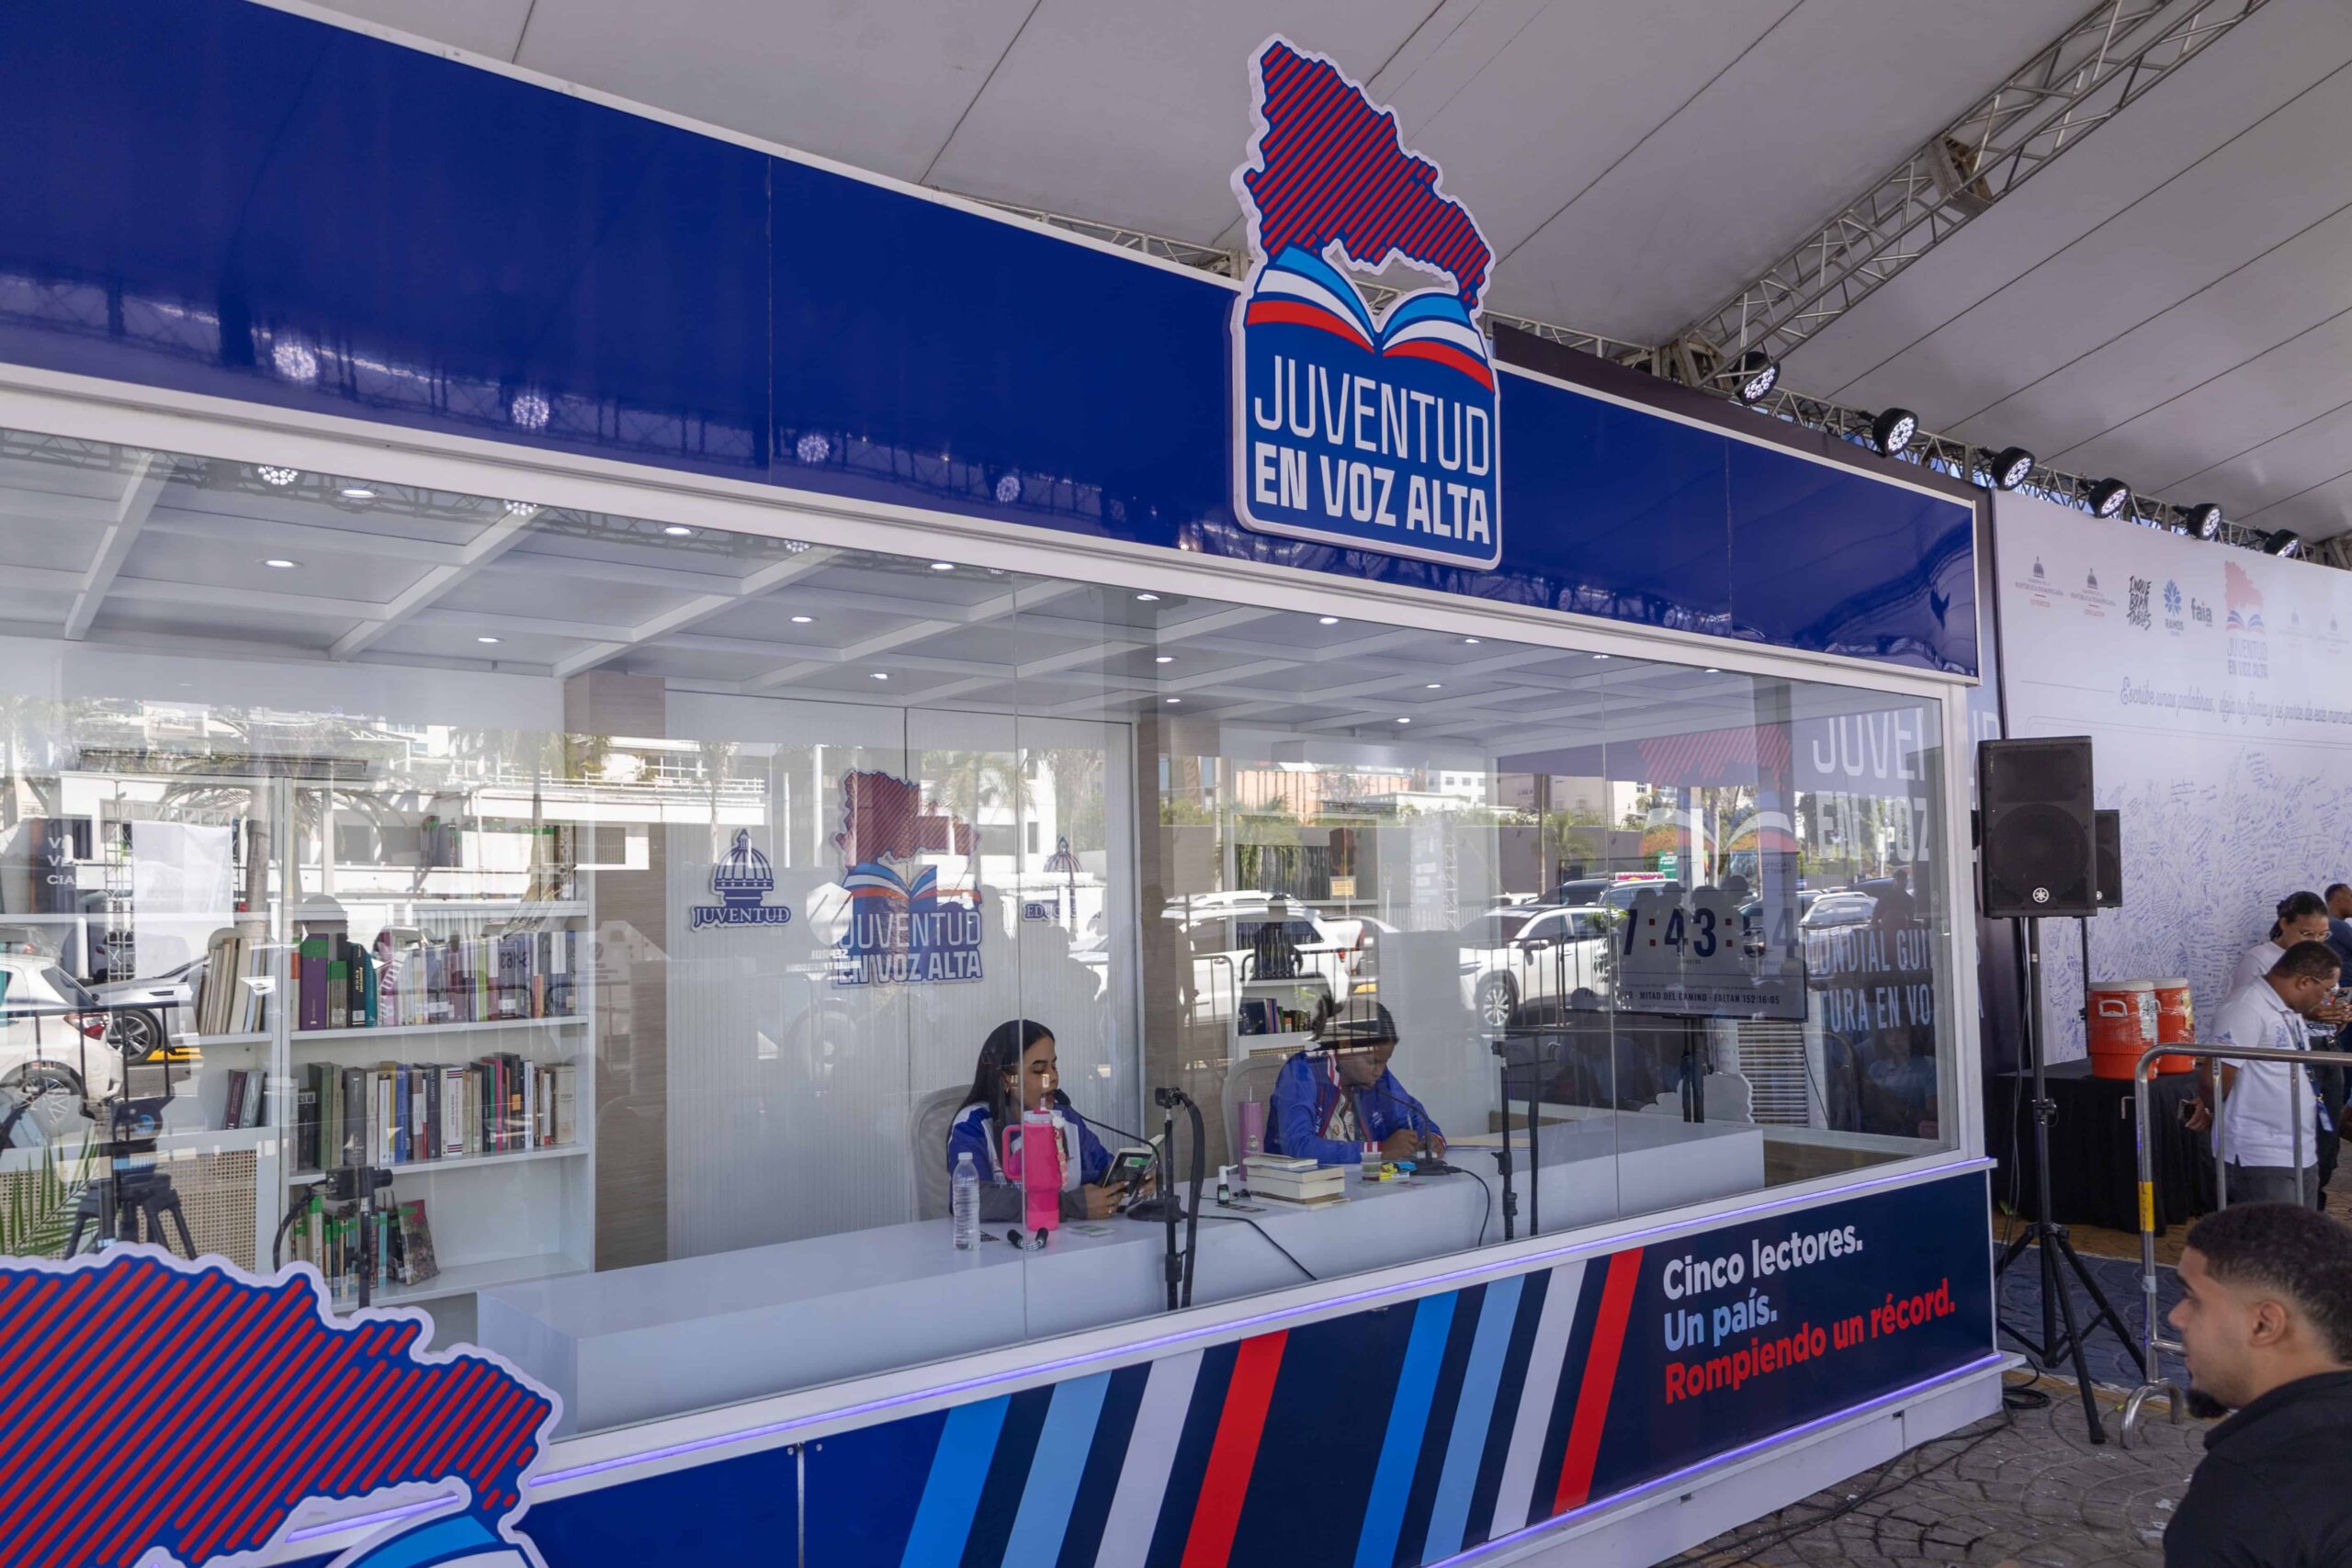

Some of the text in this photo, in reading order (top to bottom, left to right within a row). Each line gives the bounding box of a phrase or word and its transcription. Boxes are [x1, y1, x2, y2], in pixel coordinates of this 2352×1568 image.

[1255, 355, 1488, 476] JUVENTUD
[1255, 441, 1490, 545] EN VOZ ALTA
[1815, 791, 1860, 860] EN
[695, 908, 790, 927] JUVENTUD
[838, 911, 981, 949] JUVENTUD
[838, 951, 982, 984] EN VOZ ALTA
[1896, 929, 1932, 971] GUI
[1640, 992, 1661, 1000] MITAD
[1664, 992, 1677, 1000] DEL
[1679, 992, 1707, 1002] CAMINO
[1714, 994, 1739, 1003] FALTAN
[1743, 995, 1780, 1004] 152:16:05
[1875, 986, 1900, 1029] EN
[1905, 983, 1934, 1026] VO
[1663, 1225, 1863, 1301] Cinco lectores.
[1664, 1287, 1777, 1352] Un país.
[1666, 1278, 1955, 1404] Rompiendo un récord.
